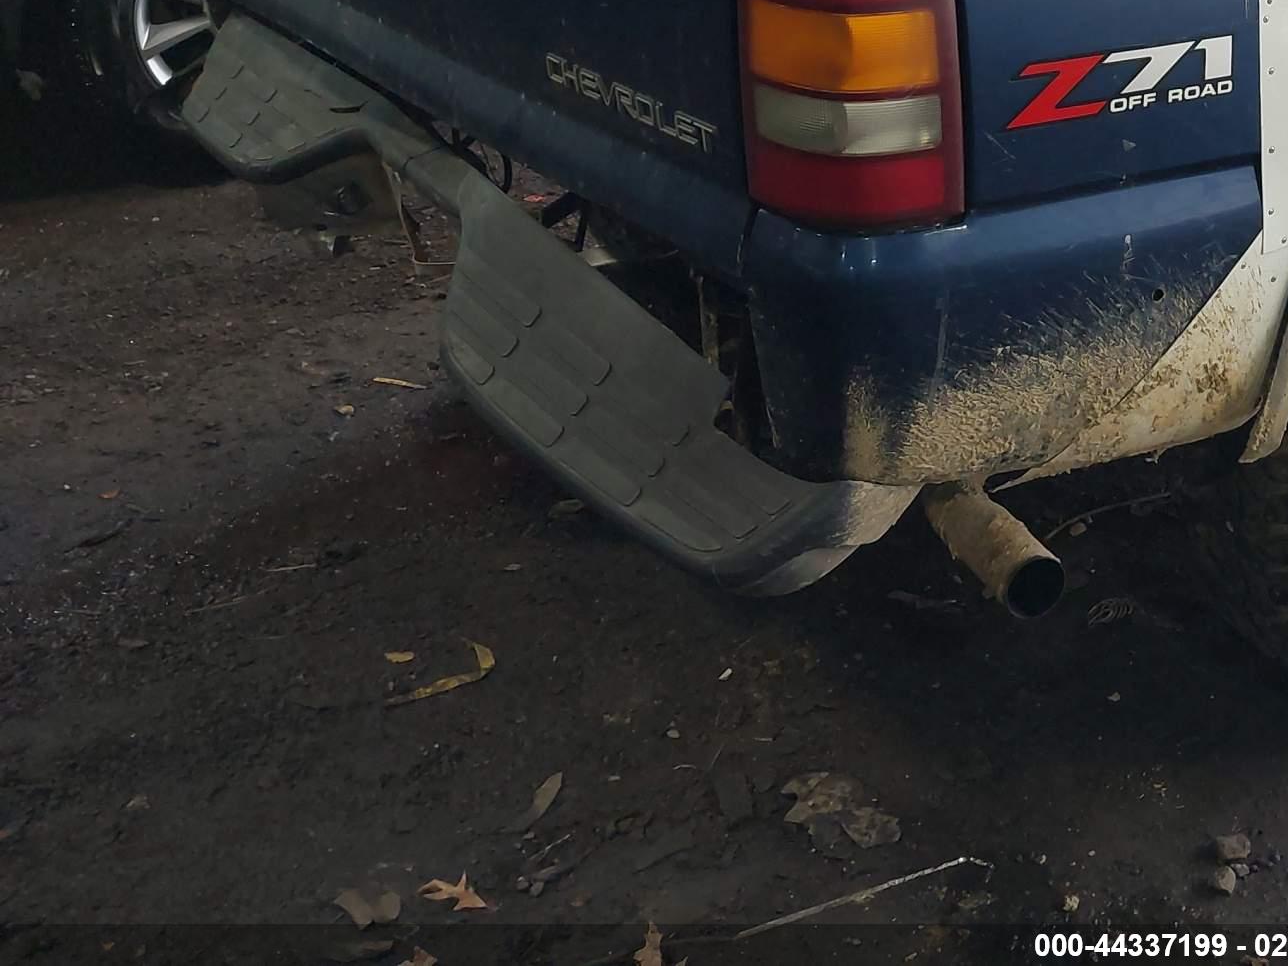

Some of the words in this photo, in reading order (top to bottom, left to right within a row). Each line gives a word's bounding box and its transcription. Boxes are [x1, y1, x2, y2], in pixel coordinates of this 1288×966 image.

[546, 52, 718, 154] CHEVROLET
[1006, 34, 1233, 130] Z71
[1110, 92, 1157, 114] OFF
[1167, 79, 1234, 104] ROAD
